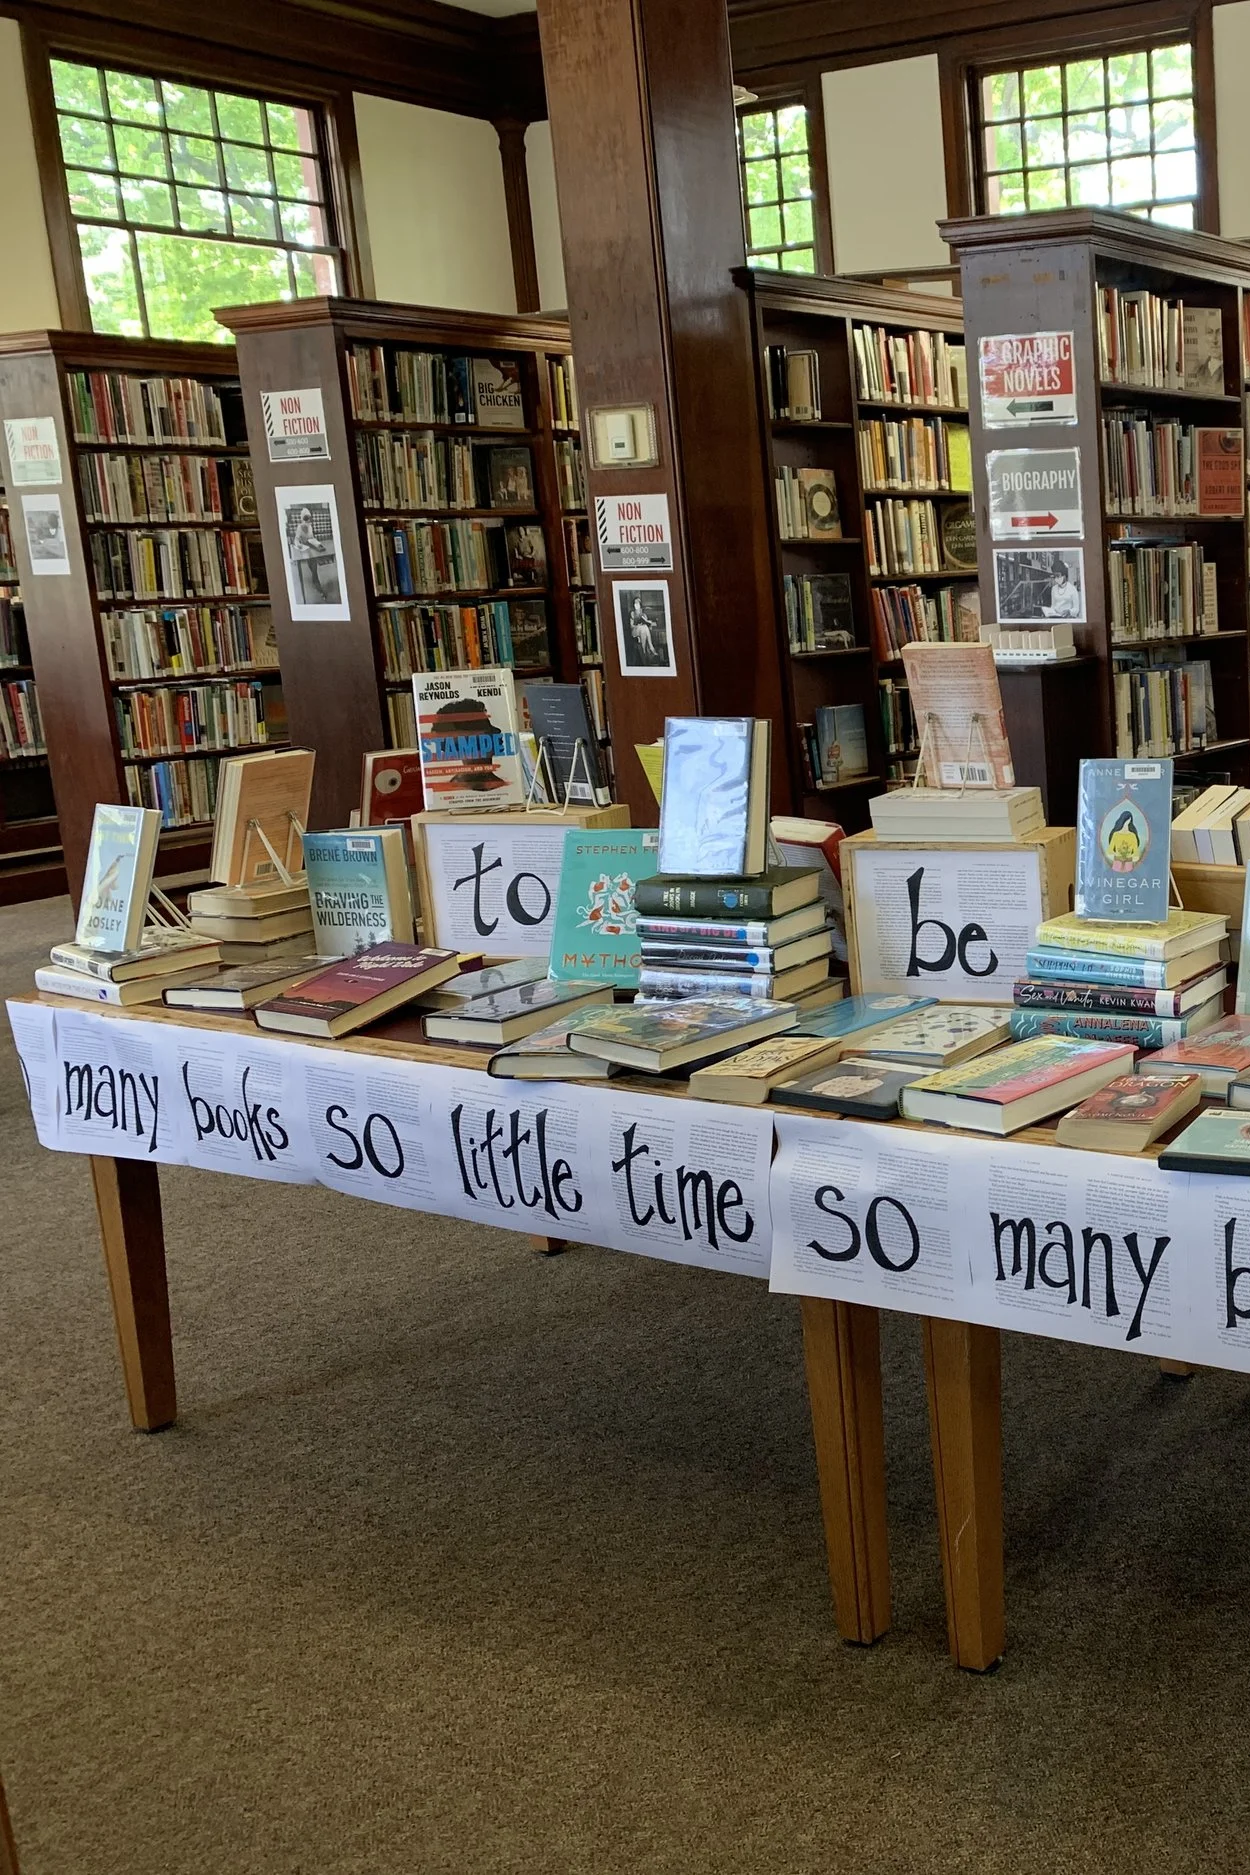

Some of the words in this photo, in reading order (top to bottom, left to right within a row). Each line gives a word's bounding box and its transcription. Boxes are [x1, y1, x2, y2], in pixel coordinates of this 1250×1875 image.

[1001, 337, 1070, 365] GRAPHIC
[478, 382, 494, 394] BIG
[1003, 367, 1061, 393] NOVELS
[280, 397, 301, 414] NON
[479, 394, 521, 407] CHICKEN
[283, 416, 320, 435] FICTION
[21, 426, 38, 442] NON
[24, 444, 55, 460] FICTION
[1002, 469, 1076, 492] BIOGRAPHY
[617, 502, 642, 521] NON
[619, 524, 664, 543] FICTION
[621, 546, 649, 554] 600-800
[622, 557, 650, 565] 800-999
[425, 682, 451, 691] JASON
[477, 688, 502, 698] KENDI
[419, 690, 460, 701] REYNOLDS
[420, 732, 520, 763] STAMPED
[1088, 768, 1121, 777] ANNE
[309, 846, 341, 862] BRENÉ
[343, 850, 378, 862] BROWN
[576, 845, 638, 855] STEPHEN
[643, 846, 659, 855] FR
[453, 842, 551, 936] to
[1086, 878, 1161, 889] VINEGAR
[315, 892, 369, 909] BRAVING
[370, 895, 384, 905] THE
[1102, 894, 1144, 905] GIRL
[316, 911, 386, 927] WILDERNESS
[906, 867, 999, 977] be
[700, 928, 720, 936] BIG
[723, 929, 737, 938] DE
[563, 953, 642, 969] MYTHO
[1019, 984, 1043, 1003] Sex
[1099, 996, 1126, 1006] KEVIN
[1130, 998, 1156, 1009] KWAN
[1073, 1017, 1150, 1032] ANNALENA
[1108, 1080, 1190, 1089] DRAGON
[64, 1060, 158, 1153] many
[182, 1061, 289, 1161] books
[451, 1104, 582, 1221] little
[612, 1122, 754, 1250] time
[990, 1212, 1171, 1341] many
